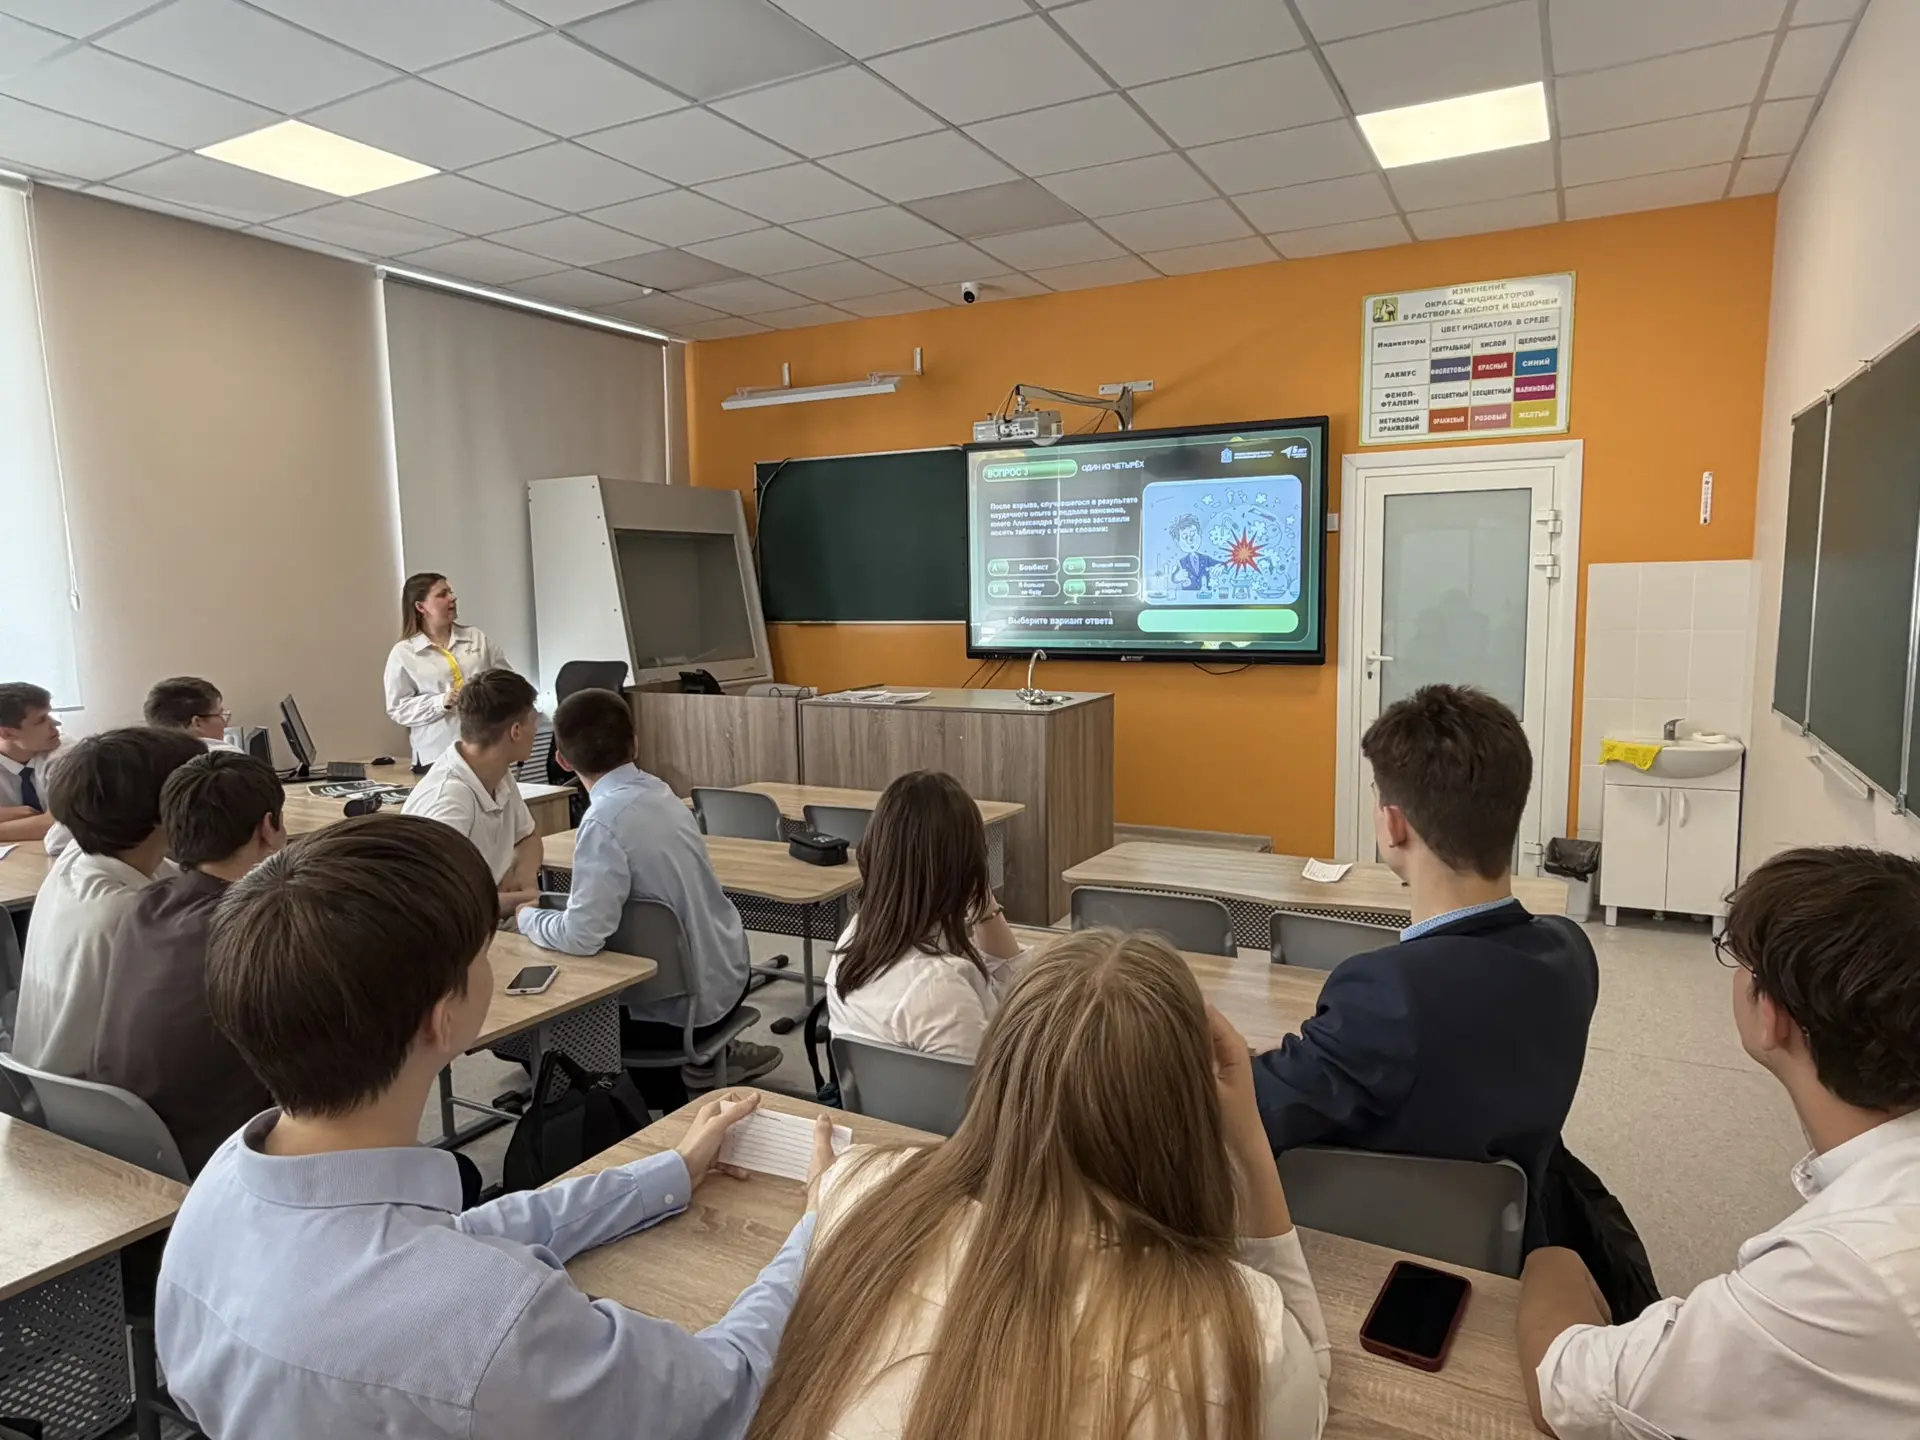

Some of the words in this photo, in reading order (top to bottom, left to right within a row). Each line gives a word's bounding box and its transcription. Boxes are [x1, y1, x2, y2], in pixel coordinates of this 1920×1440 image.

[1452, 283, 1507, 295] ИЗМЕНЕНИЕ
[1425, 298, 1466, 309] ОКРАСКИ
[1467, 290, 1535, 303] ИНДИКАТОРОВ
[1411, 308, 1461, 319] РАСТВОРАХ
[1464, 304, 1500, 313] КИСЛОТ
[1511, 298, 1558, 309] ЩЕЛОЧЕЙ
[1441, 325, 1460, 333] ЦВЕТ
[1462, 320, 1513, 331] ИНДИКАТОРА
[1523, 316, 1551, 325] СРЕДЕ
[1377, 338, 1426, 349] Индикаторы
[1480, 340, 1507, 348] КИСЛОЙ
[1518, 334, 1556, 345] ЩЕЛОЧНОЙ
[1431, 343, 1471, 352] НЕЙТРАЛЬНОЙ
[1478, 361, 1508, 371] КРАСНЫЙ
[1522, 358, 1551, 367] СИНИЙ
[1384, 370, 1417, 379] ЛАКМУС
[1431, 365, 1471, 375] ФИОЛЕТОВЫЙ
[1473, 387, 1512, 397] БЕСЦВЕТНЫЙ
[1516, 383, 1555, 393] МАЛИНОВЫЙ
[1385, 391, 1416, 399] ФЕНОЛ-
[1431, 392, 1468, 400] БЕСЦВЕТНЫЙ
[1381, 398, 1419, 408] ФТАЛЕИН
[1379, 415, 1420, 425] МЕТИЛОВЫЙ
[1433, 416, 1465, 425] ОРАНЖЕВЫЙ
[1474, 412, 1507, 422] РОЗОВЫЙ
[1378, 423, 1420, 432] ОРАНЖЕВЫЙ
[1081, 464, 1101, 473] ОДИН
[1112, 460, 1145, 470] ЧЕТЫРЁХ
[987, 468, 1022, 478] ВОПРОС
[1023, 468, 1029, 476] 3
[1008, 617, 1048, 625] Выберите
[1050, 617, 1083, 626] вариант
[1085, 616, 1114, 625] ответа
